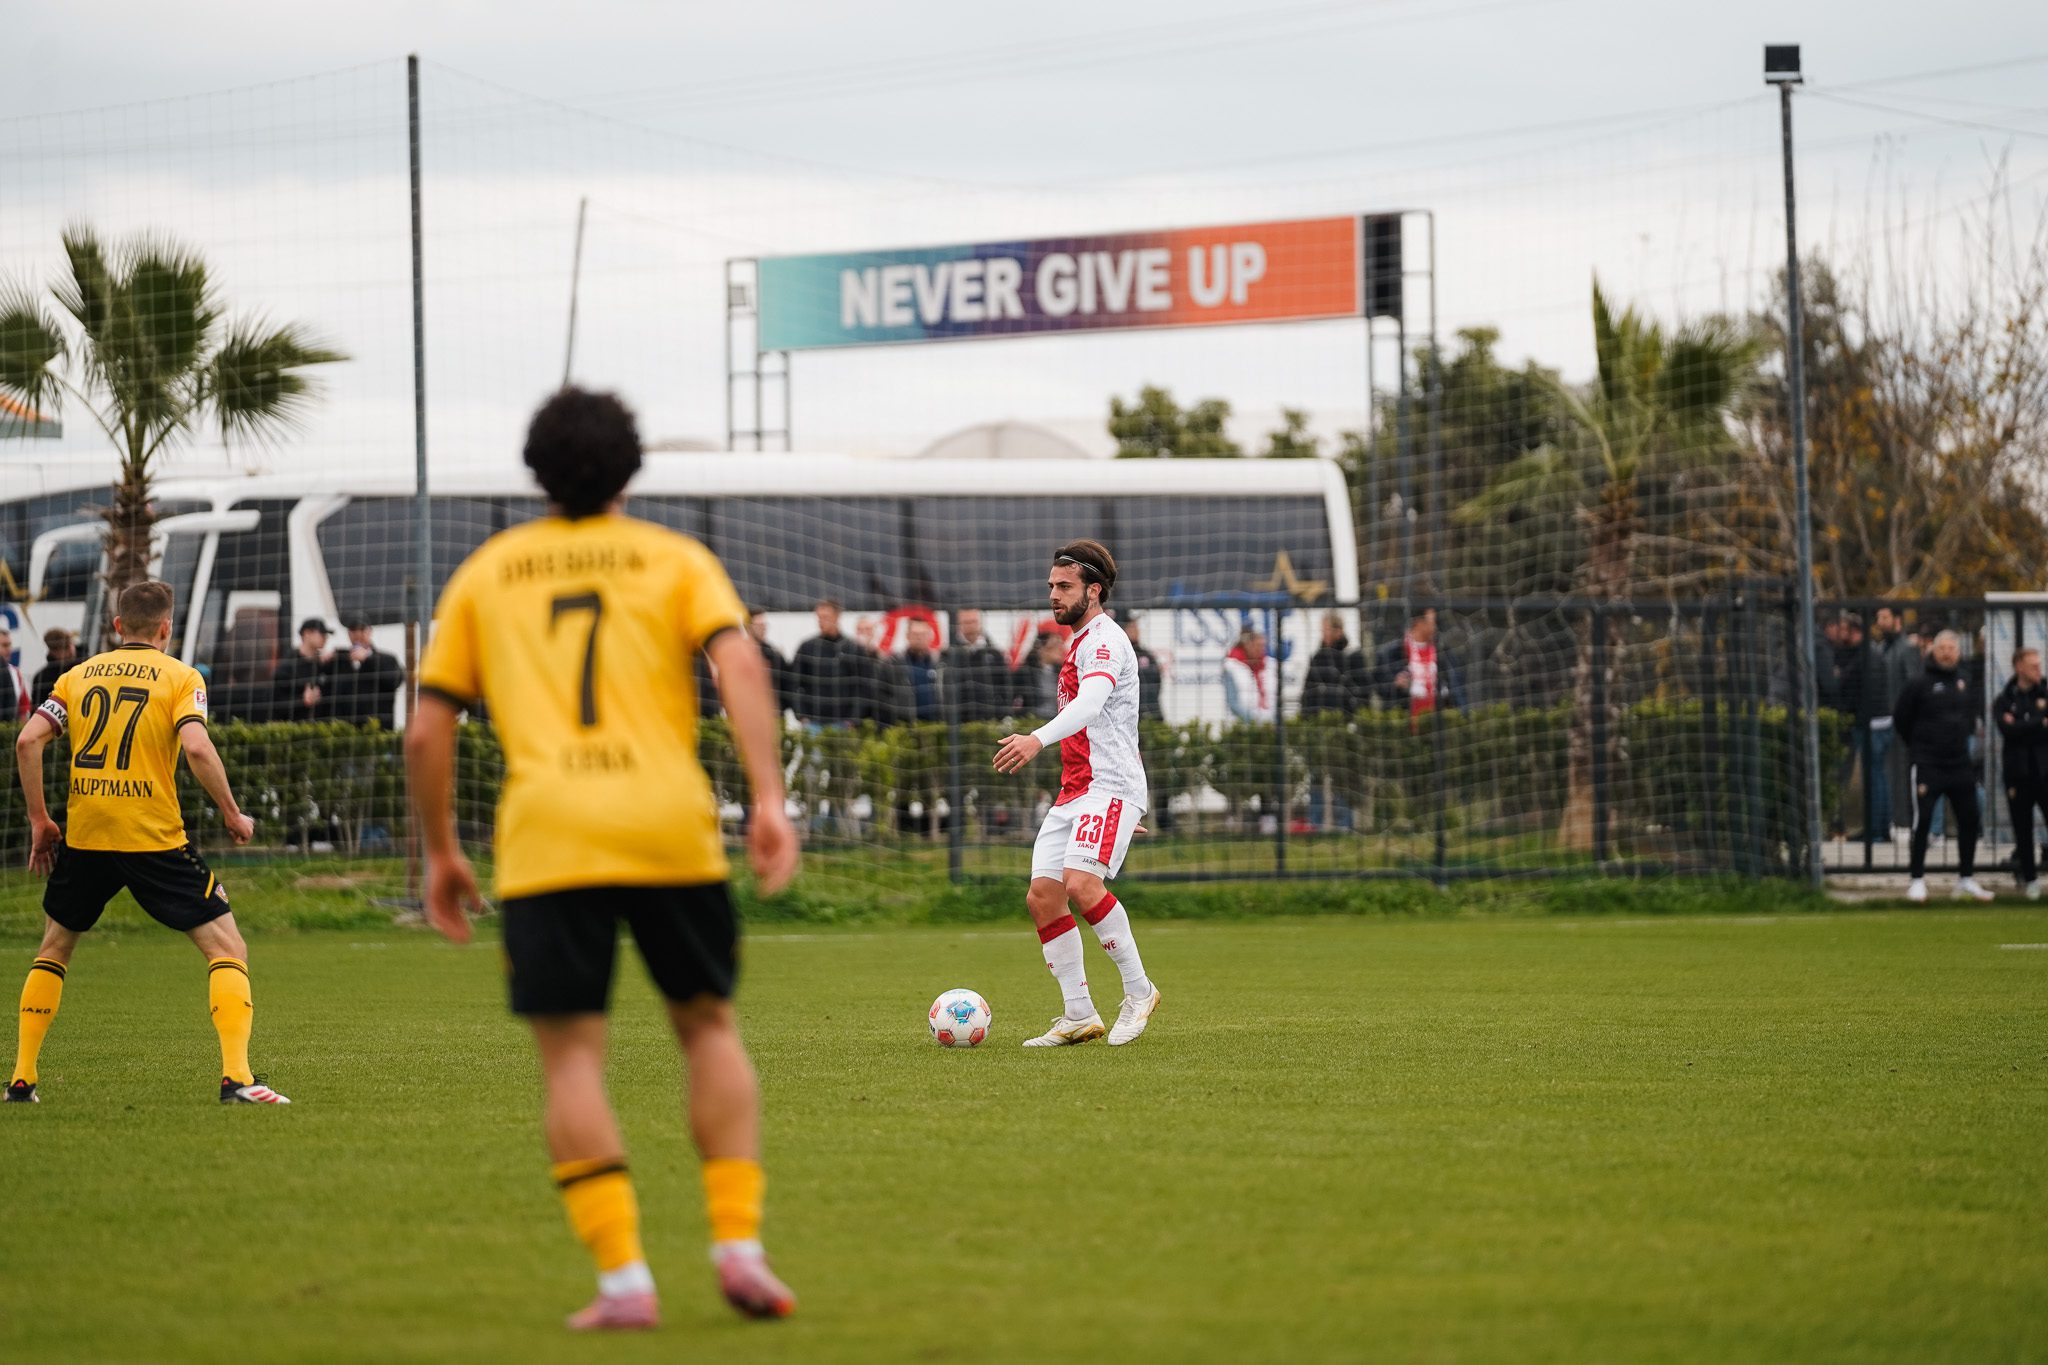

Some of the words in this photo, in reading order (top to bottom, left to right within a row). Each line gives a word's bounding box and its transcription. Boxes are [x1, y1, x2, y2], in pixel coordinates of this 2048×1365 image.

[841, 257, 1025, 329] NEVER
[1035, 248, 1173, 318] GIVE
[1187, 241, 1267, 308] UP
[549, 591, 602, 725] 7
[83, 662, 162, 681] DRESDEN
[74, 685, 150, 770] 27
[70, 777, 153, 798] AUPTMANN
[1075, 813, 1104, 844] 23
[1077, 842, 1095, 850] JAKO
[1082, 857, 1097, 867] JAKO
[1101, 939, 1117, 951] WE
